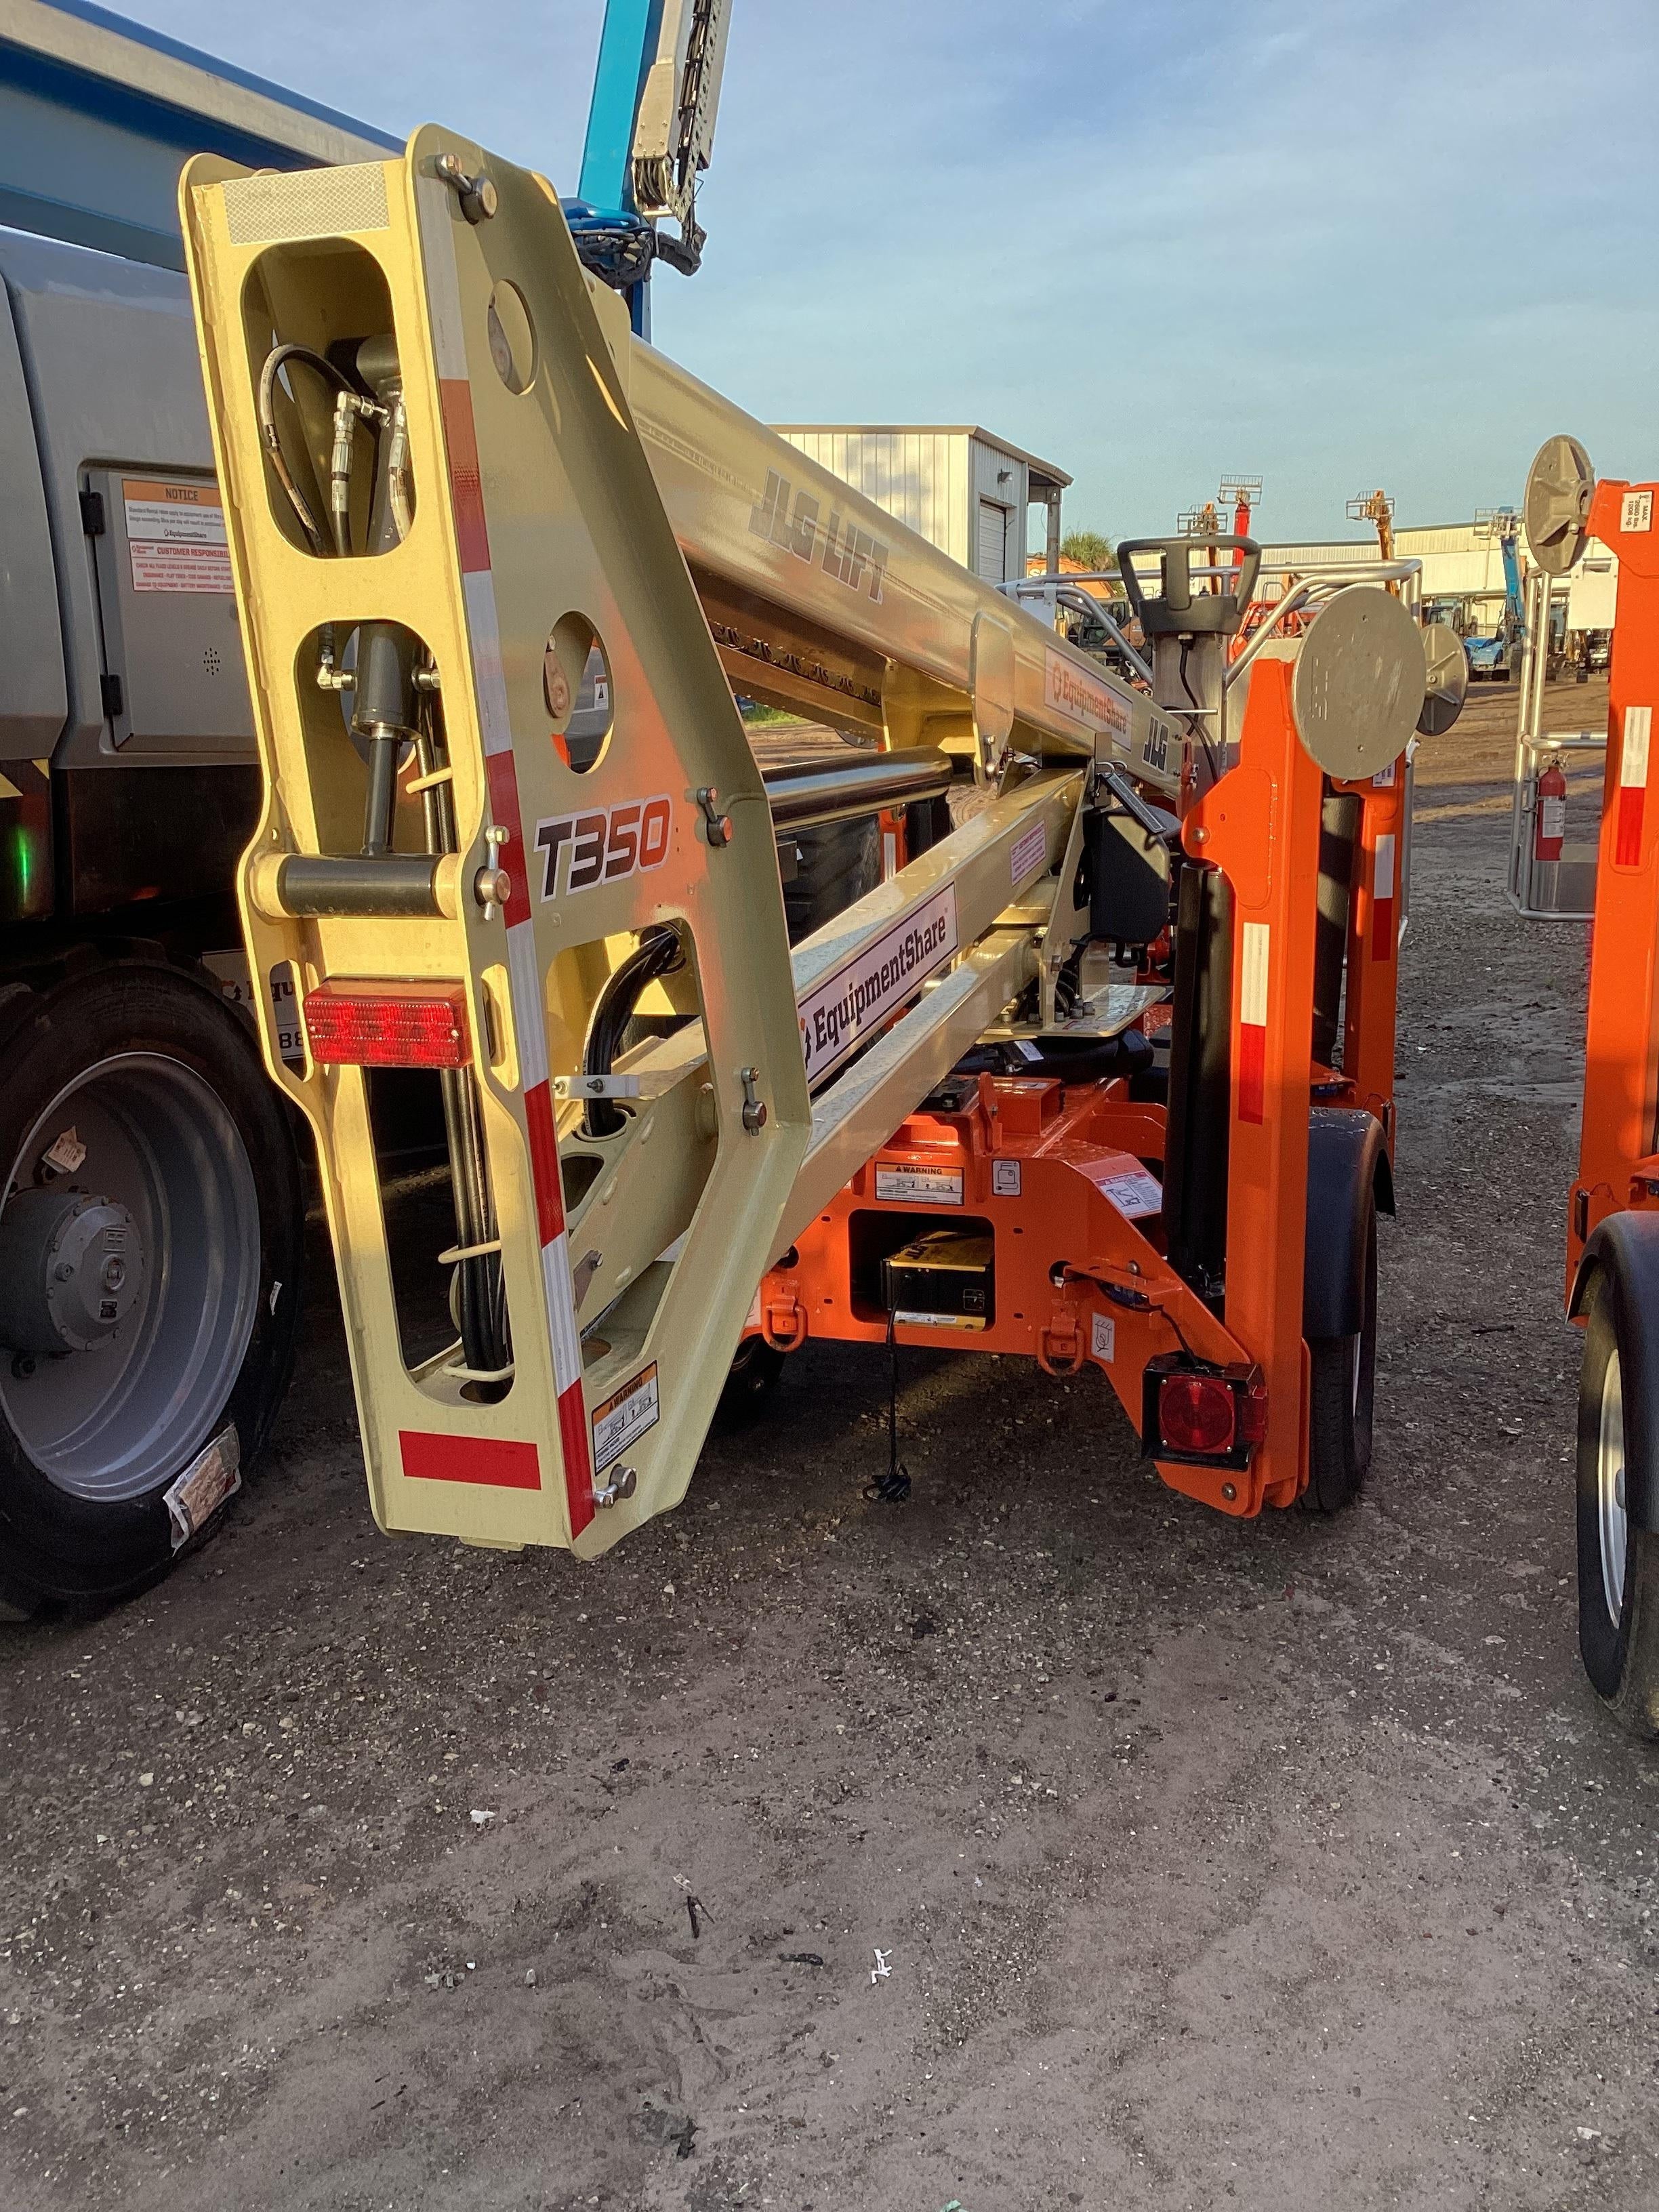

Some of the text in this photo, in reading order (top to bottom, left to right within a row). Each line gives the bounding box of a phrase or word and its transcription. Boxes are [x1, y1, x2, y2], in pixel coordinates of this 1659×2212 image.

[165, 487, 199, 501] NOTICE
[157, 546, 190, 556] CUSTOMER
[748, 466, 890, 603] JLG LIFT
[1062, 668, 1128, 735] EquipmentShare
[1142, 714, 1170, 775] JLG
[534, 794, 672, 903] T350
[813, 915, 947, 1053] EquipmentShare
[903, 1166, 943, 1175] WARNING
[613, 1376, 643, 1409] WARNING
